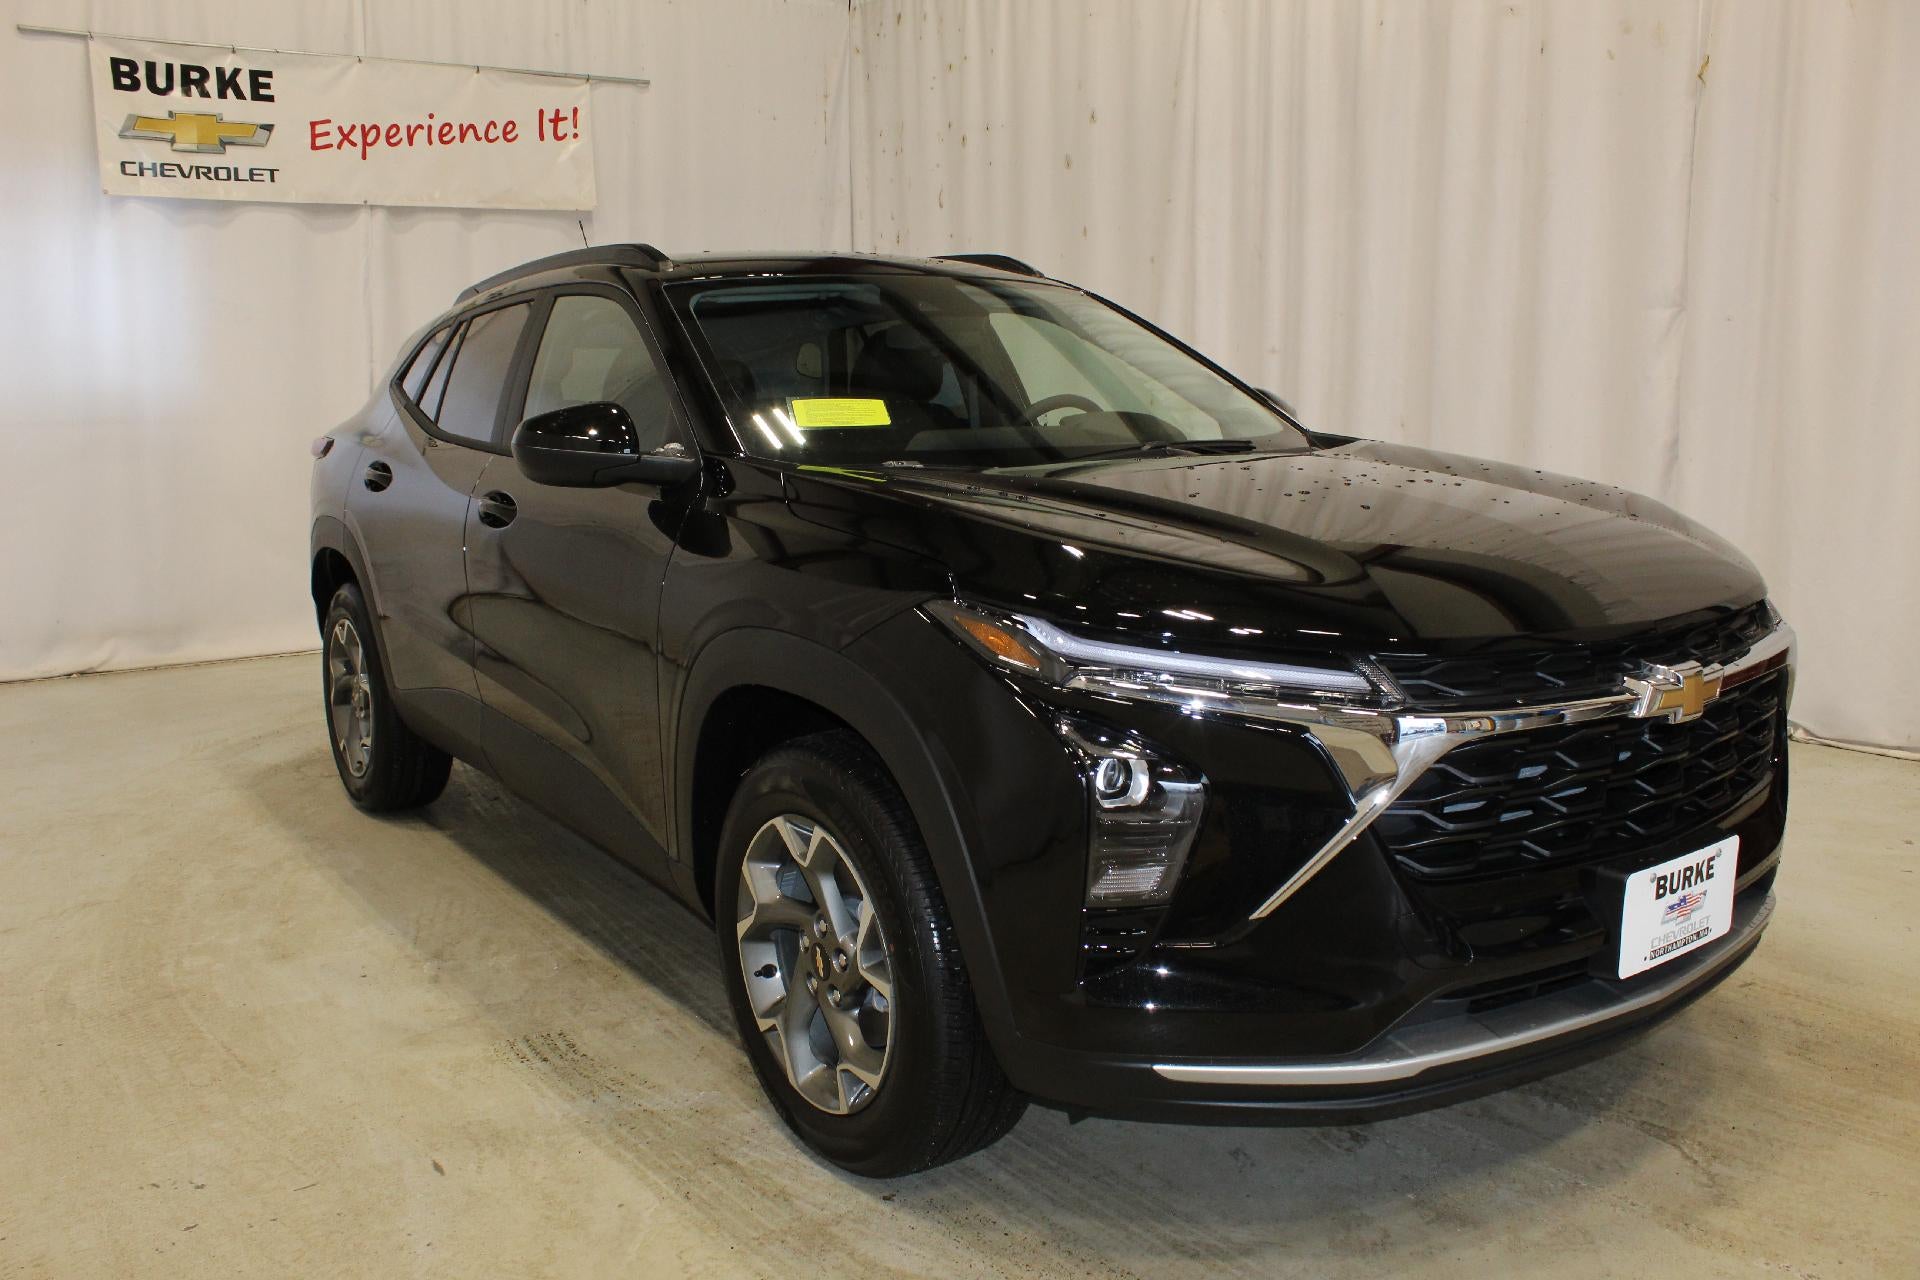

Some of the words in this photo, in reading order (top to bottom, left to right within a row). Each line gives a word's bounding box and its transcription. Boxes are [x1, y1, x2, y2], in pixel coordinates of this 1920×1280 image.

[110, 57, 275, 102] BURKE
[309, 113, 519, 160] Experience
[538, 107, 580, 142] It!
[120, 161, 279, 183] CHEVROLET
[1655, 856, 1715, 900] BURKE
[1651, 915, 1711, 948] CHEVROLET
